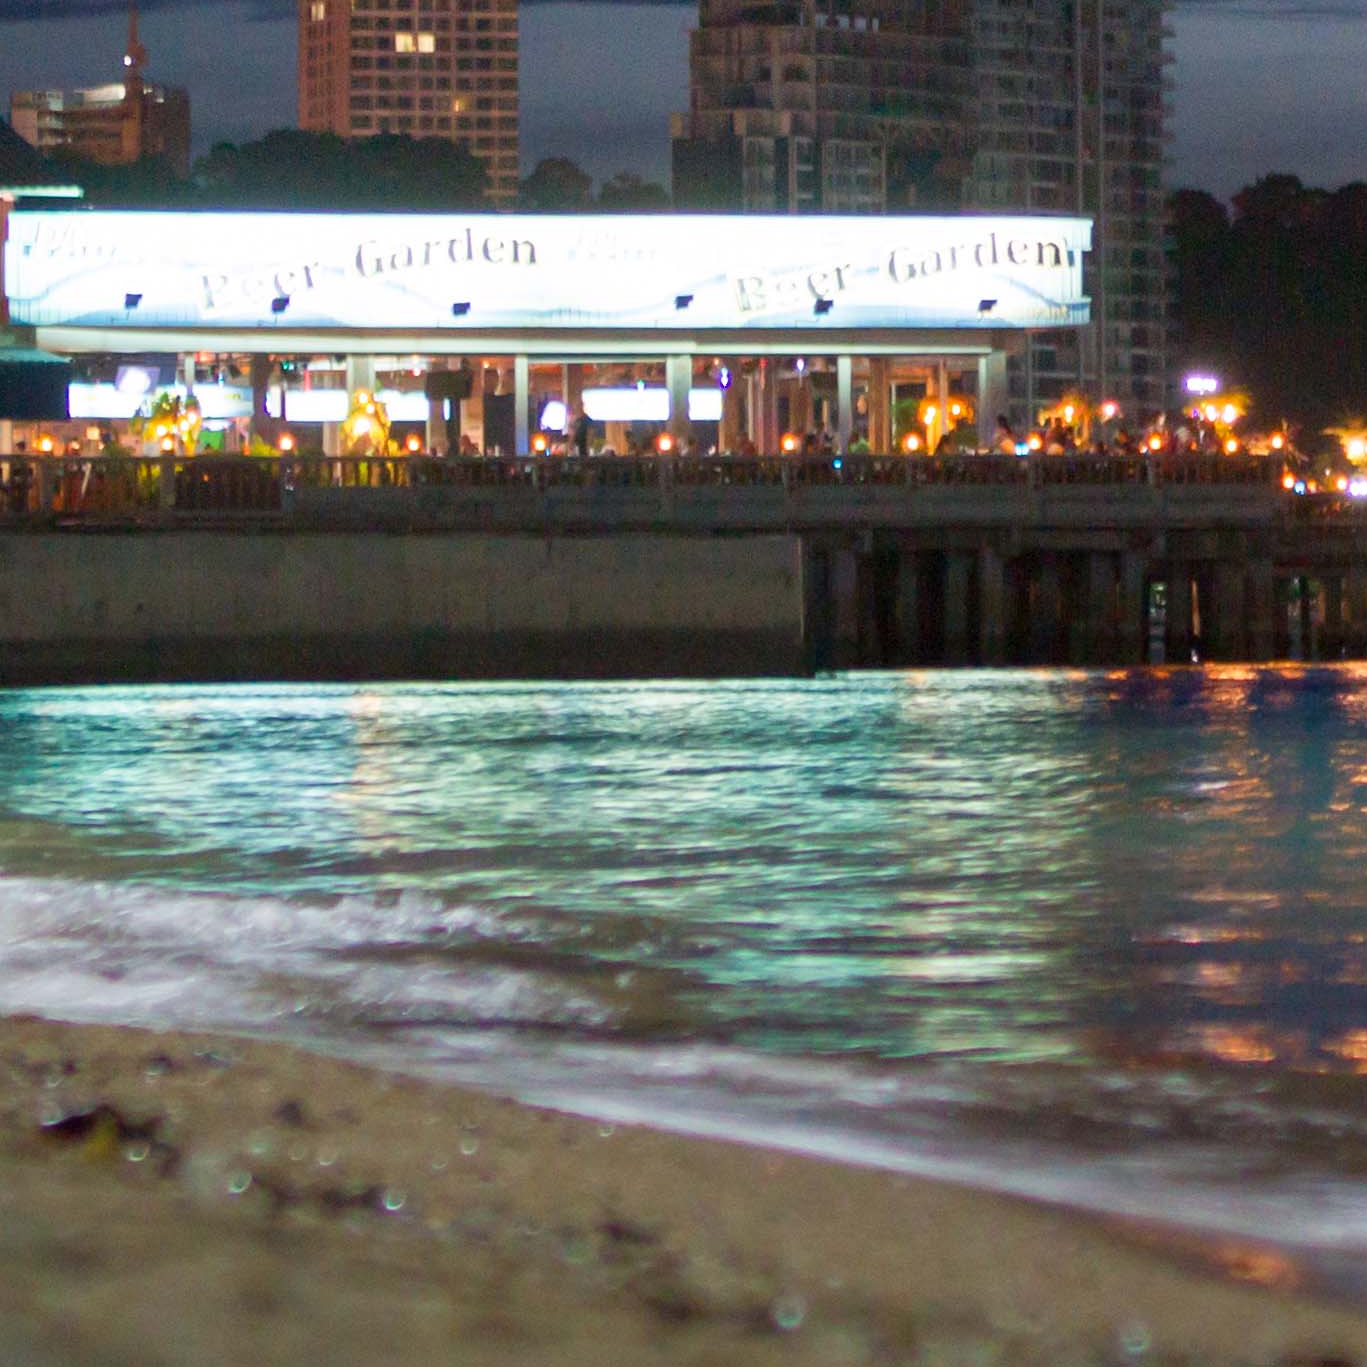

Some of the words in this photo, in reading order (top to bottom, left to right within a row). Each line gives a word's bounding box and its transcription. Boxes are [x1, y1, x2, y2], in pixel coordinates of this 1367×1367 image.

[355, 229, 537, 278] Garden
[736, 264, 850, 312] Beer
[888, 233, 1064, 282] Garden
